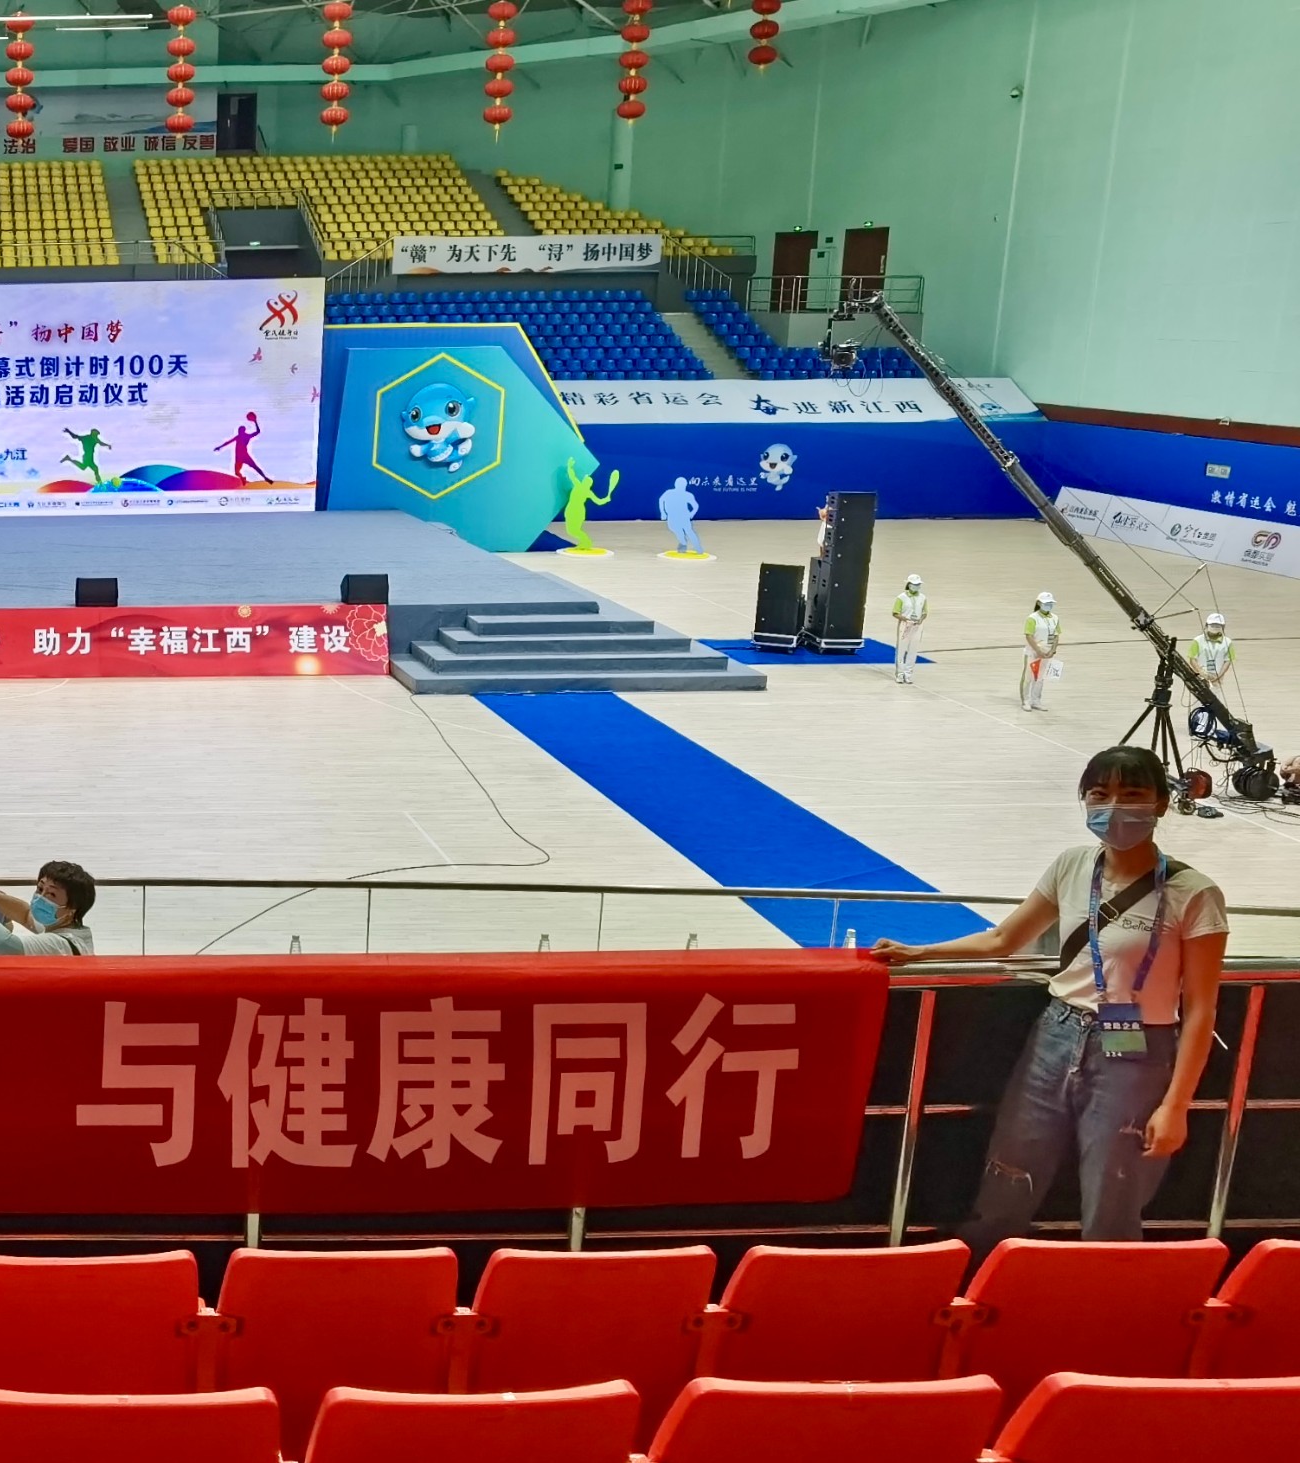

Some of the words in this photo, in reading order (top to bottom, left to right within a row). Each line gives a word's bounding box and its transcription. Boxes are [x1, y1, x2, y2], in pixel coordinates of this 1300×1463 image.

[3, 139, 36, 154] 法治
[63, 137, 95, 153] 爱国
[104, 136, 135, 152] 敬业
[144, 135, 176, 151] 诚信
[182, 134, 215, 150] 友善
[75, 993, 800, 1169] 与健康同行
